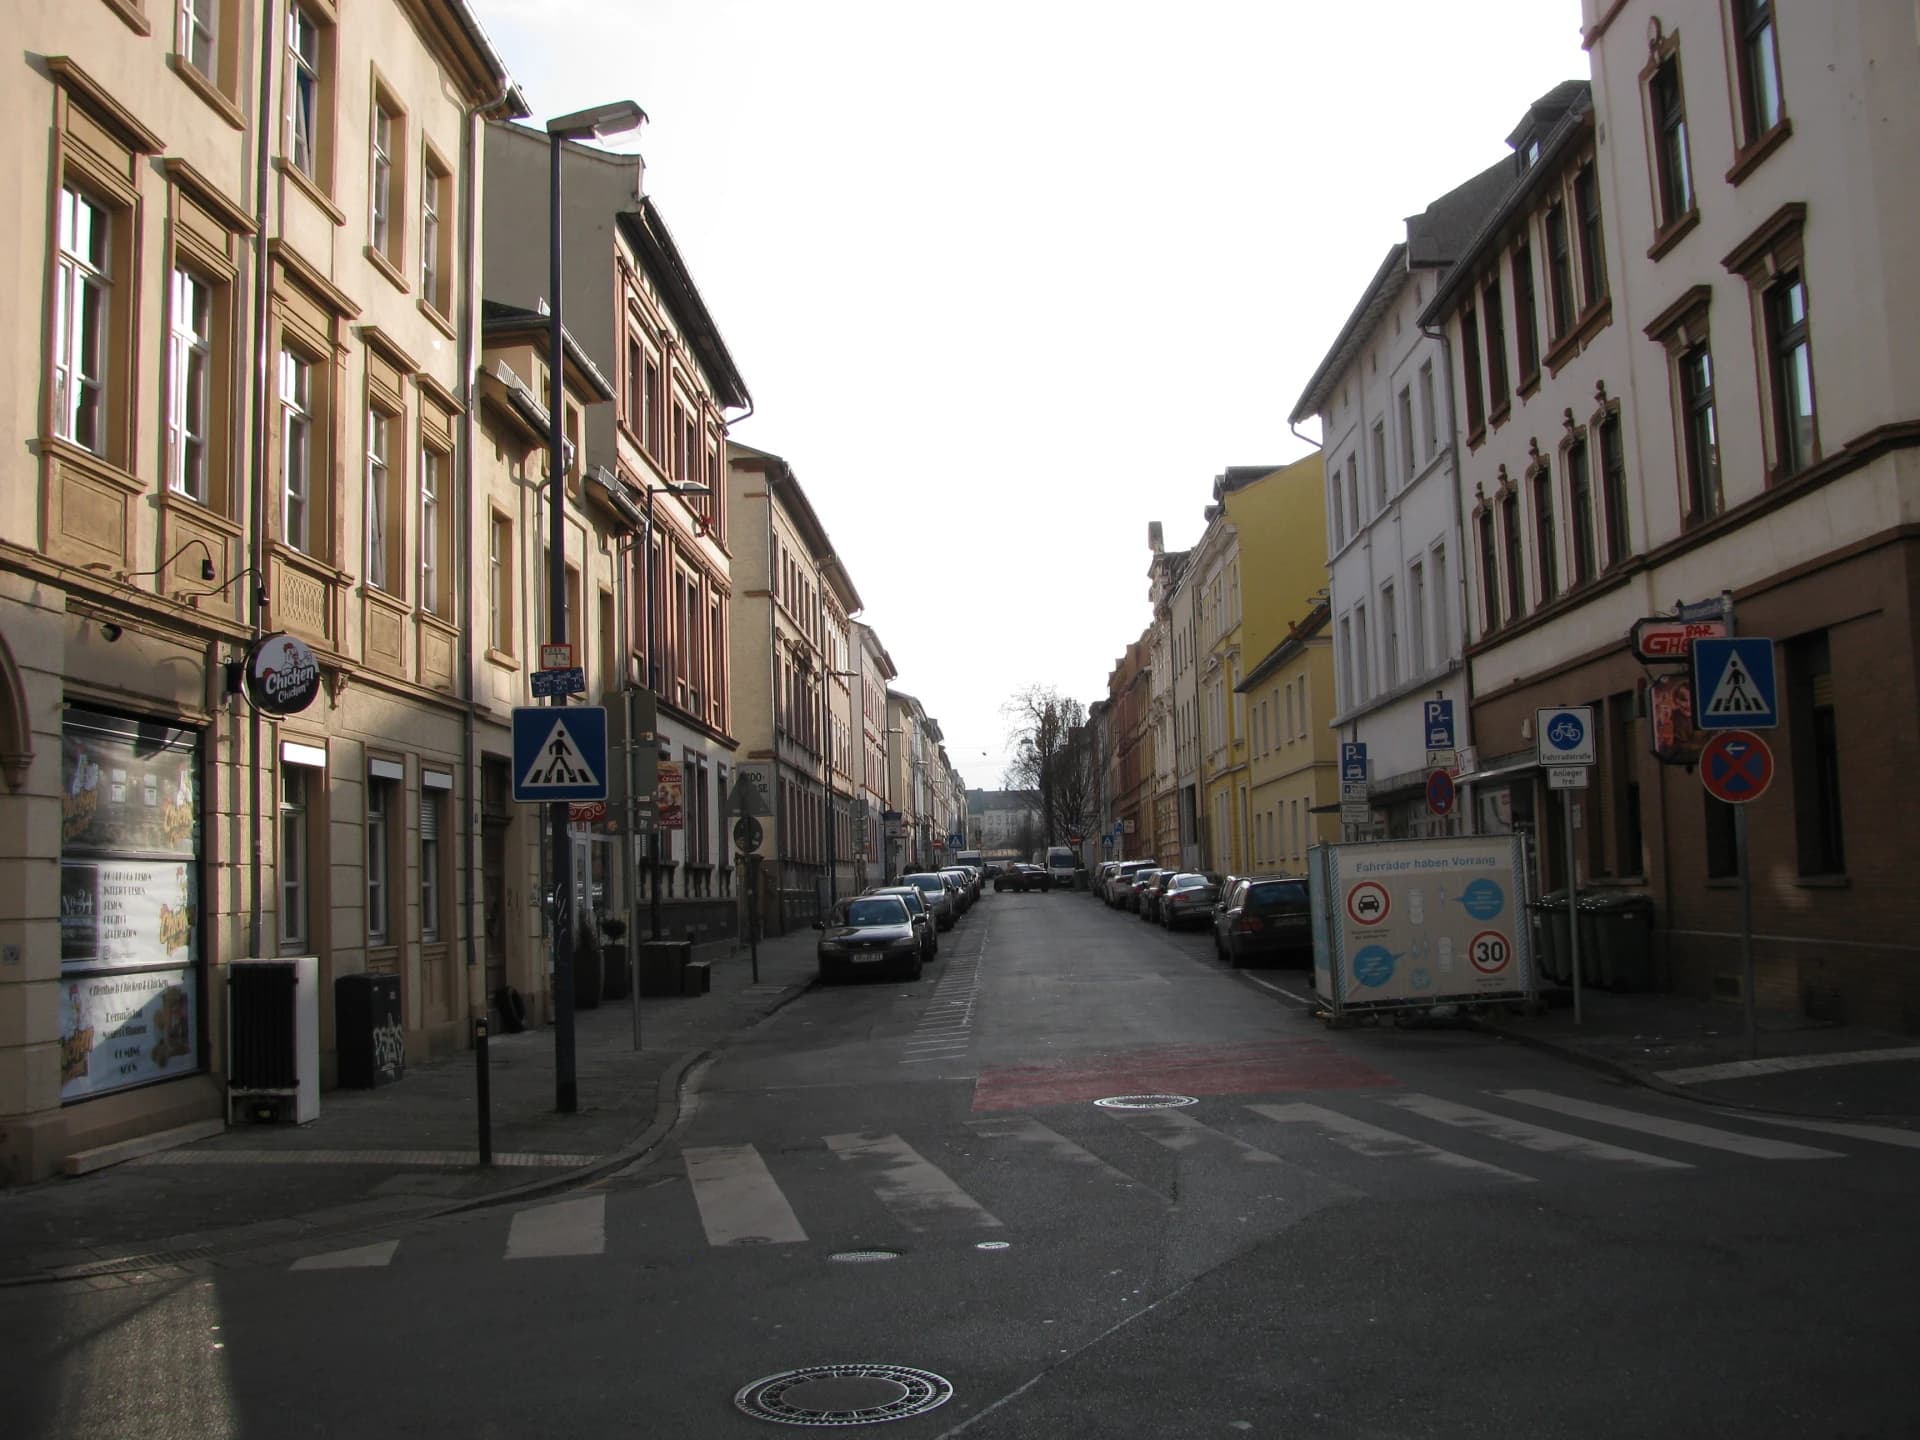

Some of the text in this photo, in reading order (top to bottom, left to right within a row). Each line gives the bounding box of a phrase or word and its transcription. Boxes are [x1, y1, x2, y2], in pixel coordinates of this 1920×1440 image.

[1685, 624, 1713, 637] BAR
[1428, 703, 1441, 723] P
[1345, 745, 1357, 761] P
[1542, 751, 1592, 761] Fahrradstraße
[1552, 769, 1584, 778] Anlieger
[758, 783, 768, 793] SE
[1356, 855, 1496, 873] Fahrräder haben Vorrang
[1476, 941, 1504, 962] 30
